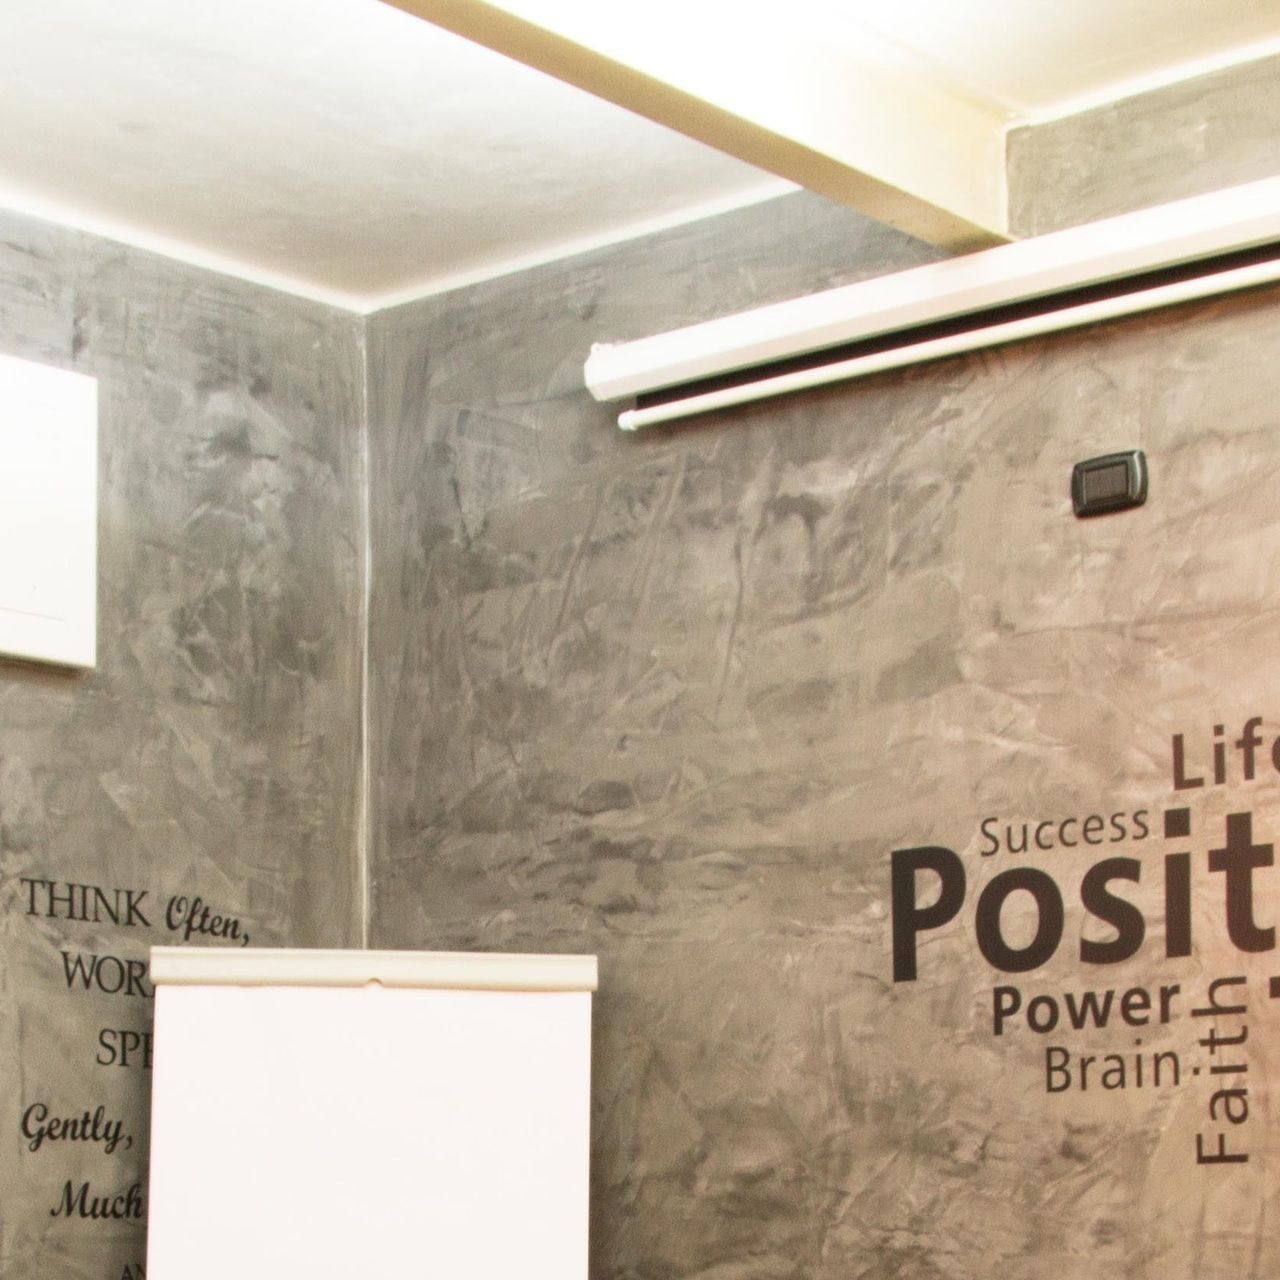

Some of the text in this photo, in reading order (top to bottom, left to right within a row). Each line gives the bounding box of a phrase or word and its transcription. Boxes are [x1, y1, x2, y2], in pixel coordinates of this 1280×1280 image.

[979, 808, 1150, 858] Success
[20, 878, 250, 947] THINK Often,
[60, 951, 155, 999] WOR
[993, 984, 1181, 1037] Power
[96, 1028, 154, 1070] SPE
[1045, 1040, 1181, 1094] Brain
[1191, 975, 1250, 1166] Faith
[21, 1102, 133, 1155] Gently,
[50, 1180, 143, 1220] Much
